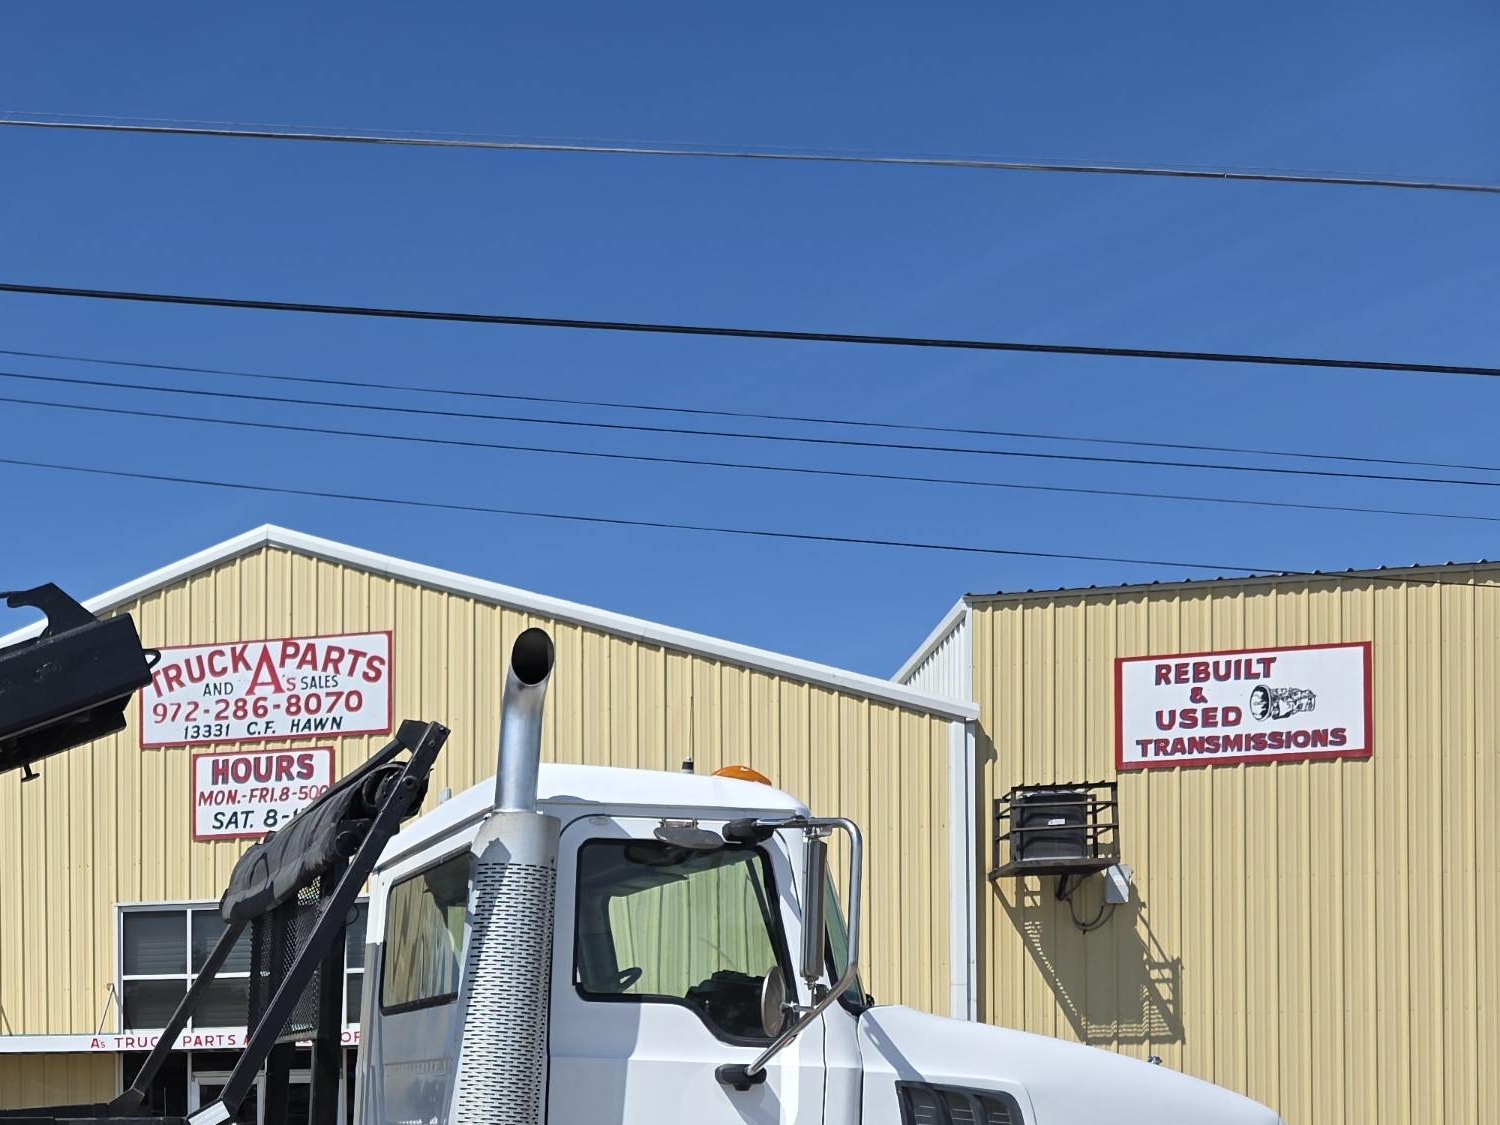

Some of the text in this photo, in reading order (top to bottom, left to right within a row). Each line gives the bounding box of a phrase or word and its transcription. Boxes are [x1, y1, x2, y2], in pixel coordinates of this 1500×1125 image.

[151, 641, 386, 698] TRUCK PARTS
[1155, 656, 1277, 686] REBUILT
[203, 682, 234, 697] AND
[301, 674, 338, 690] SALES
[1190, 686, 1208, 704] &
[153, 690, 363, 724] 972-286-8070
[1155, 705, 1242, 731] USED
[184, 716, 343, 739] 13331 C.F. HAWN
[1136, 727, 1347, 758] TRANSMISSIONS
[211, 753, 314, 786] HOURS
[212, 810, 254, 831] SAT.
[114, 1036, 159, 1049] TRUC
[183, 1034, 236, 1048] PARTS
